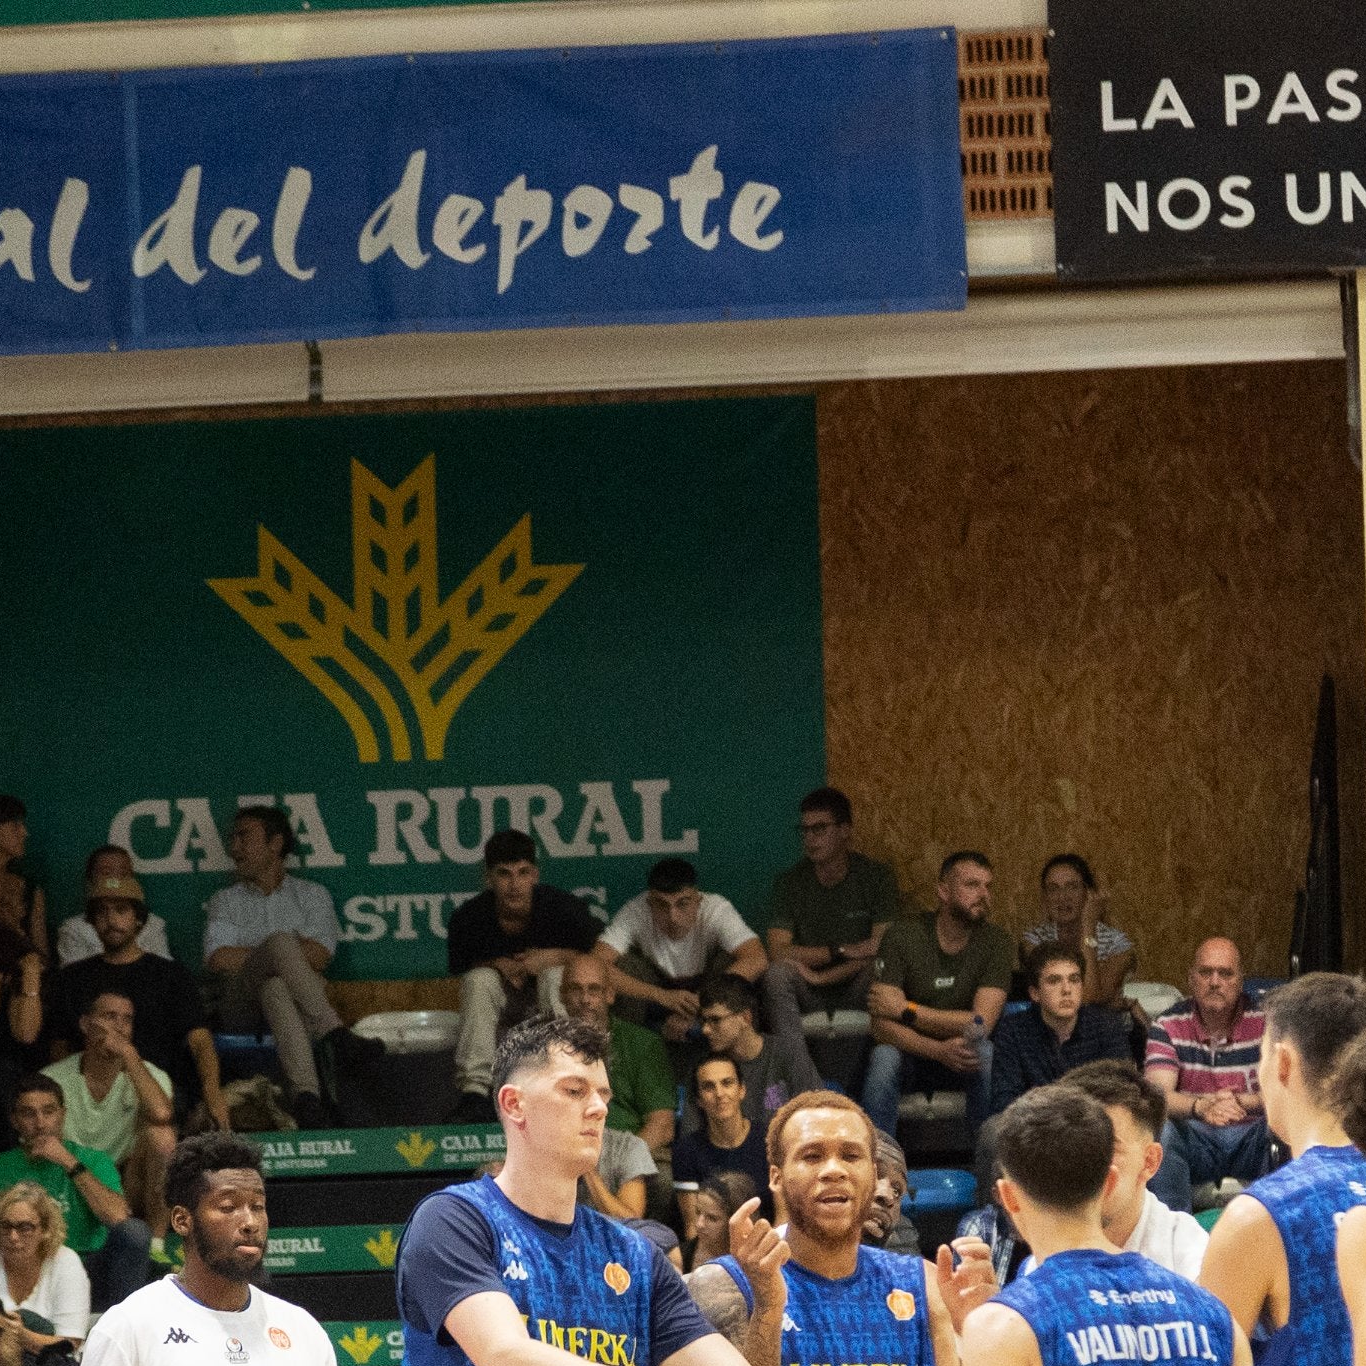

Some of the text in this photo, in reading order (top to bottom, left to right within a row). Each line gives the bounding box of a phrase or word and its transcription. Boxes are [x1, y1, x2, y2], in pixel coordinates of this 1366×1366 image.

[1099, 77, 1195, 133] LA
[132, 165, 318, 286] del
[357, 144, 784, 295] deporte
[1105, 174, 1256, 235] NOS
[108, 779, 699, 874] CAA RURAL
[261, 1138, 357, 1156] AJA RURAL
[1108, 1288, 1177, 1305] Enerthy
